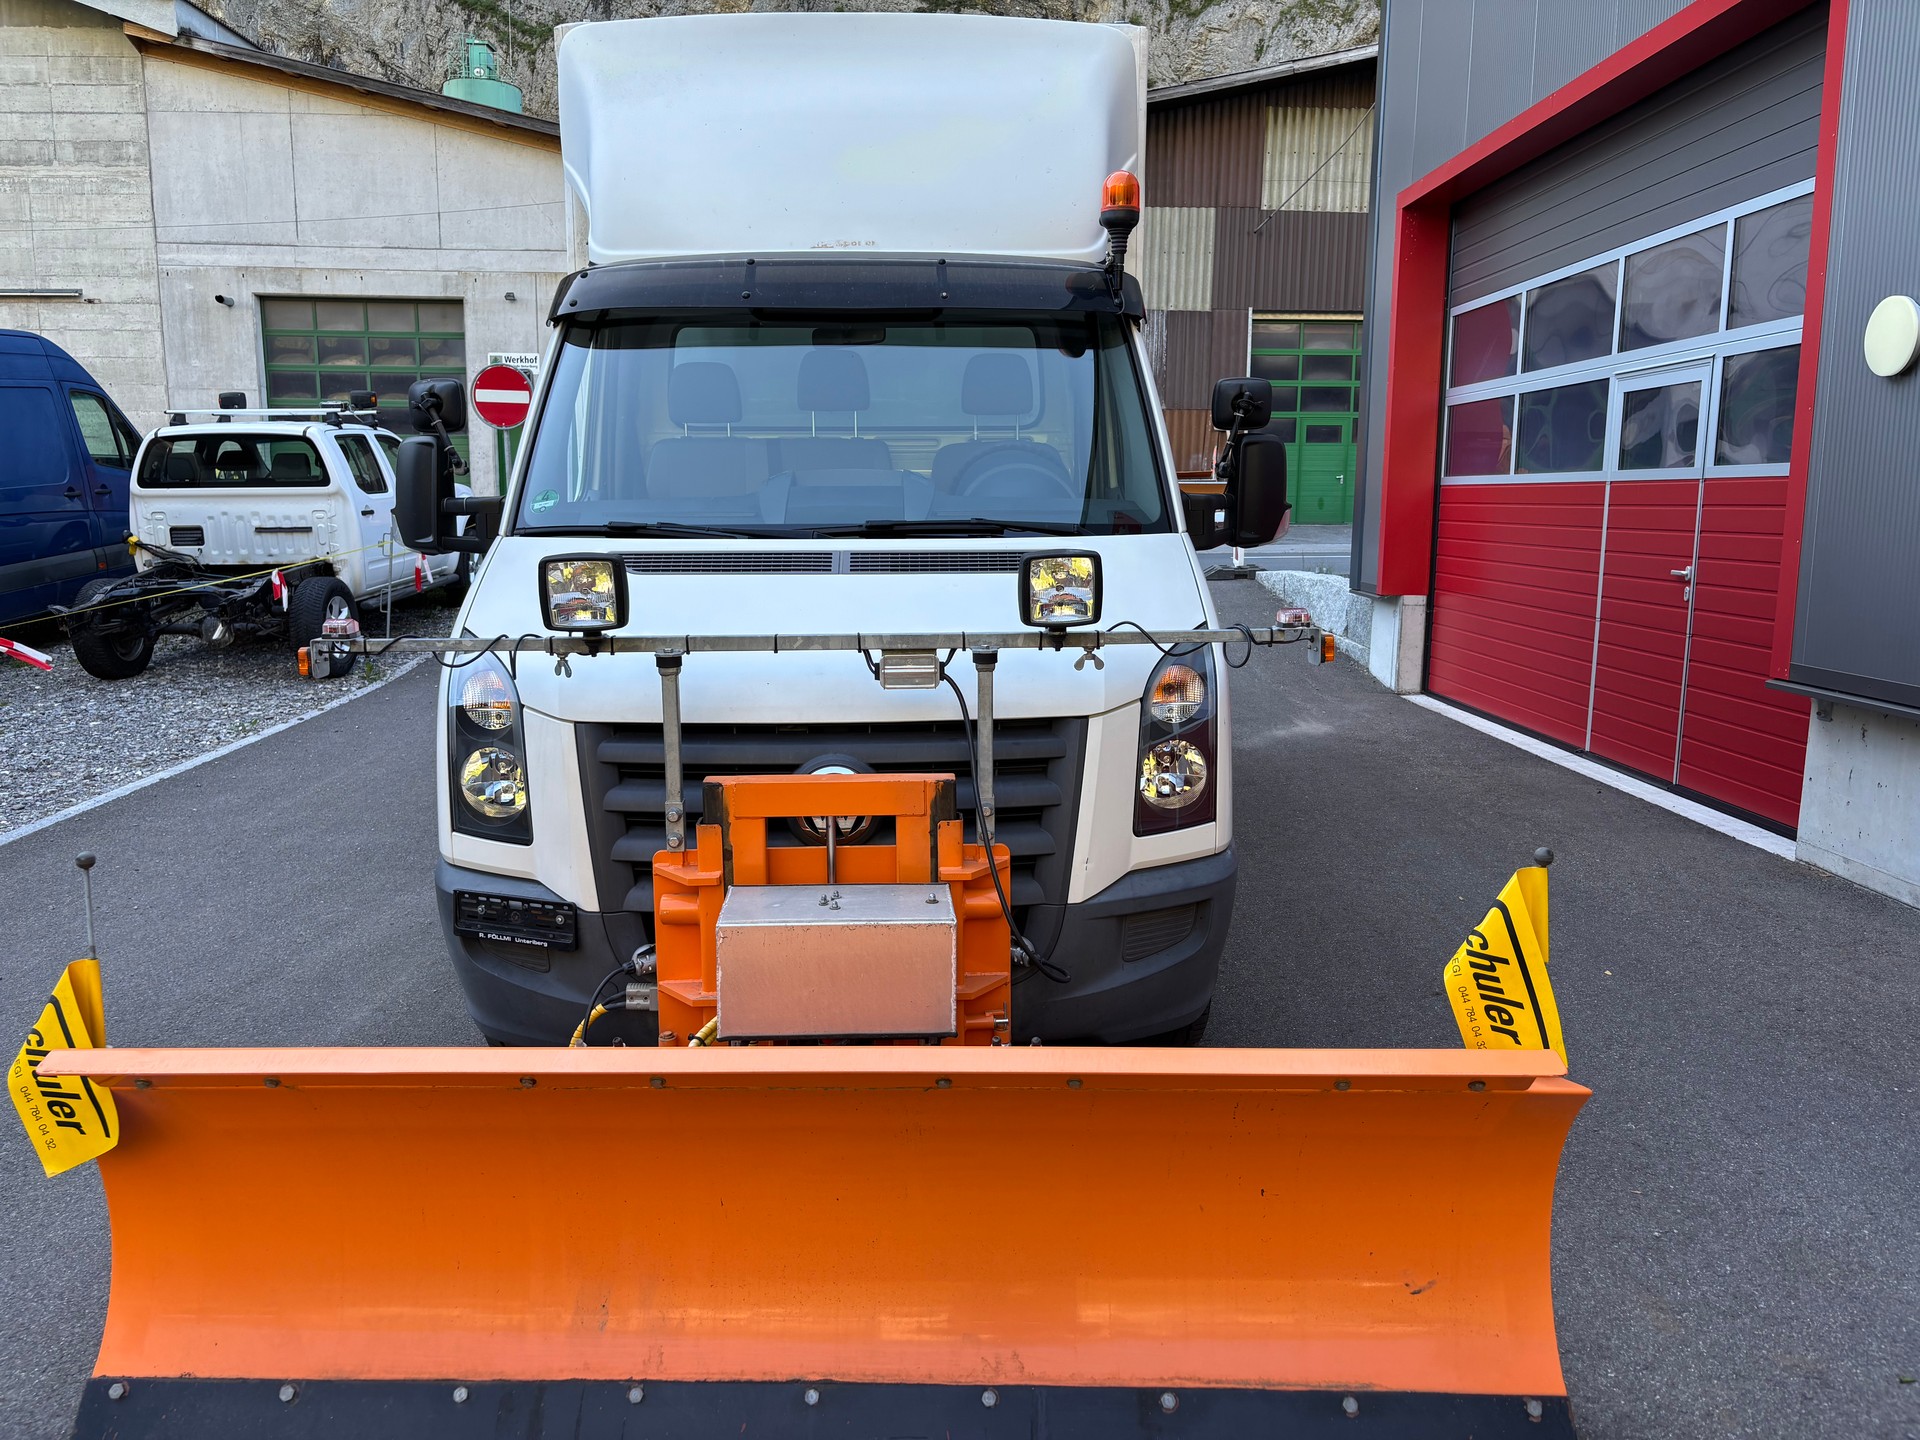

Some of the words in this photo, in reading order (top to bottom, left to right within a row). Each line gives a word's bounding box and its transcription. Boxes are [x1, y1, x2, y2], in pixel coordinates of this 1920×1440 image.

[504, 356, 538, 364] Werkhof
[487, 933, 512, 941] FÖLLMI
[515, 937, 548, 947] Unteriberg
[1458, 986, 1471, 1003] 044
[1465, 1006, 1477, 1023] 784
[1471, 1025, 1482, 1038] 04
[26, 1027, 87, 1136] culer
[20, 1086, 34, 1103] 044
[29, 1104, 44, 1121] 784
[38, 1123, 50, 1136] 04
[44, 1138, 57, 1150] 32
